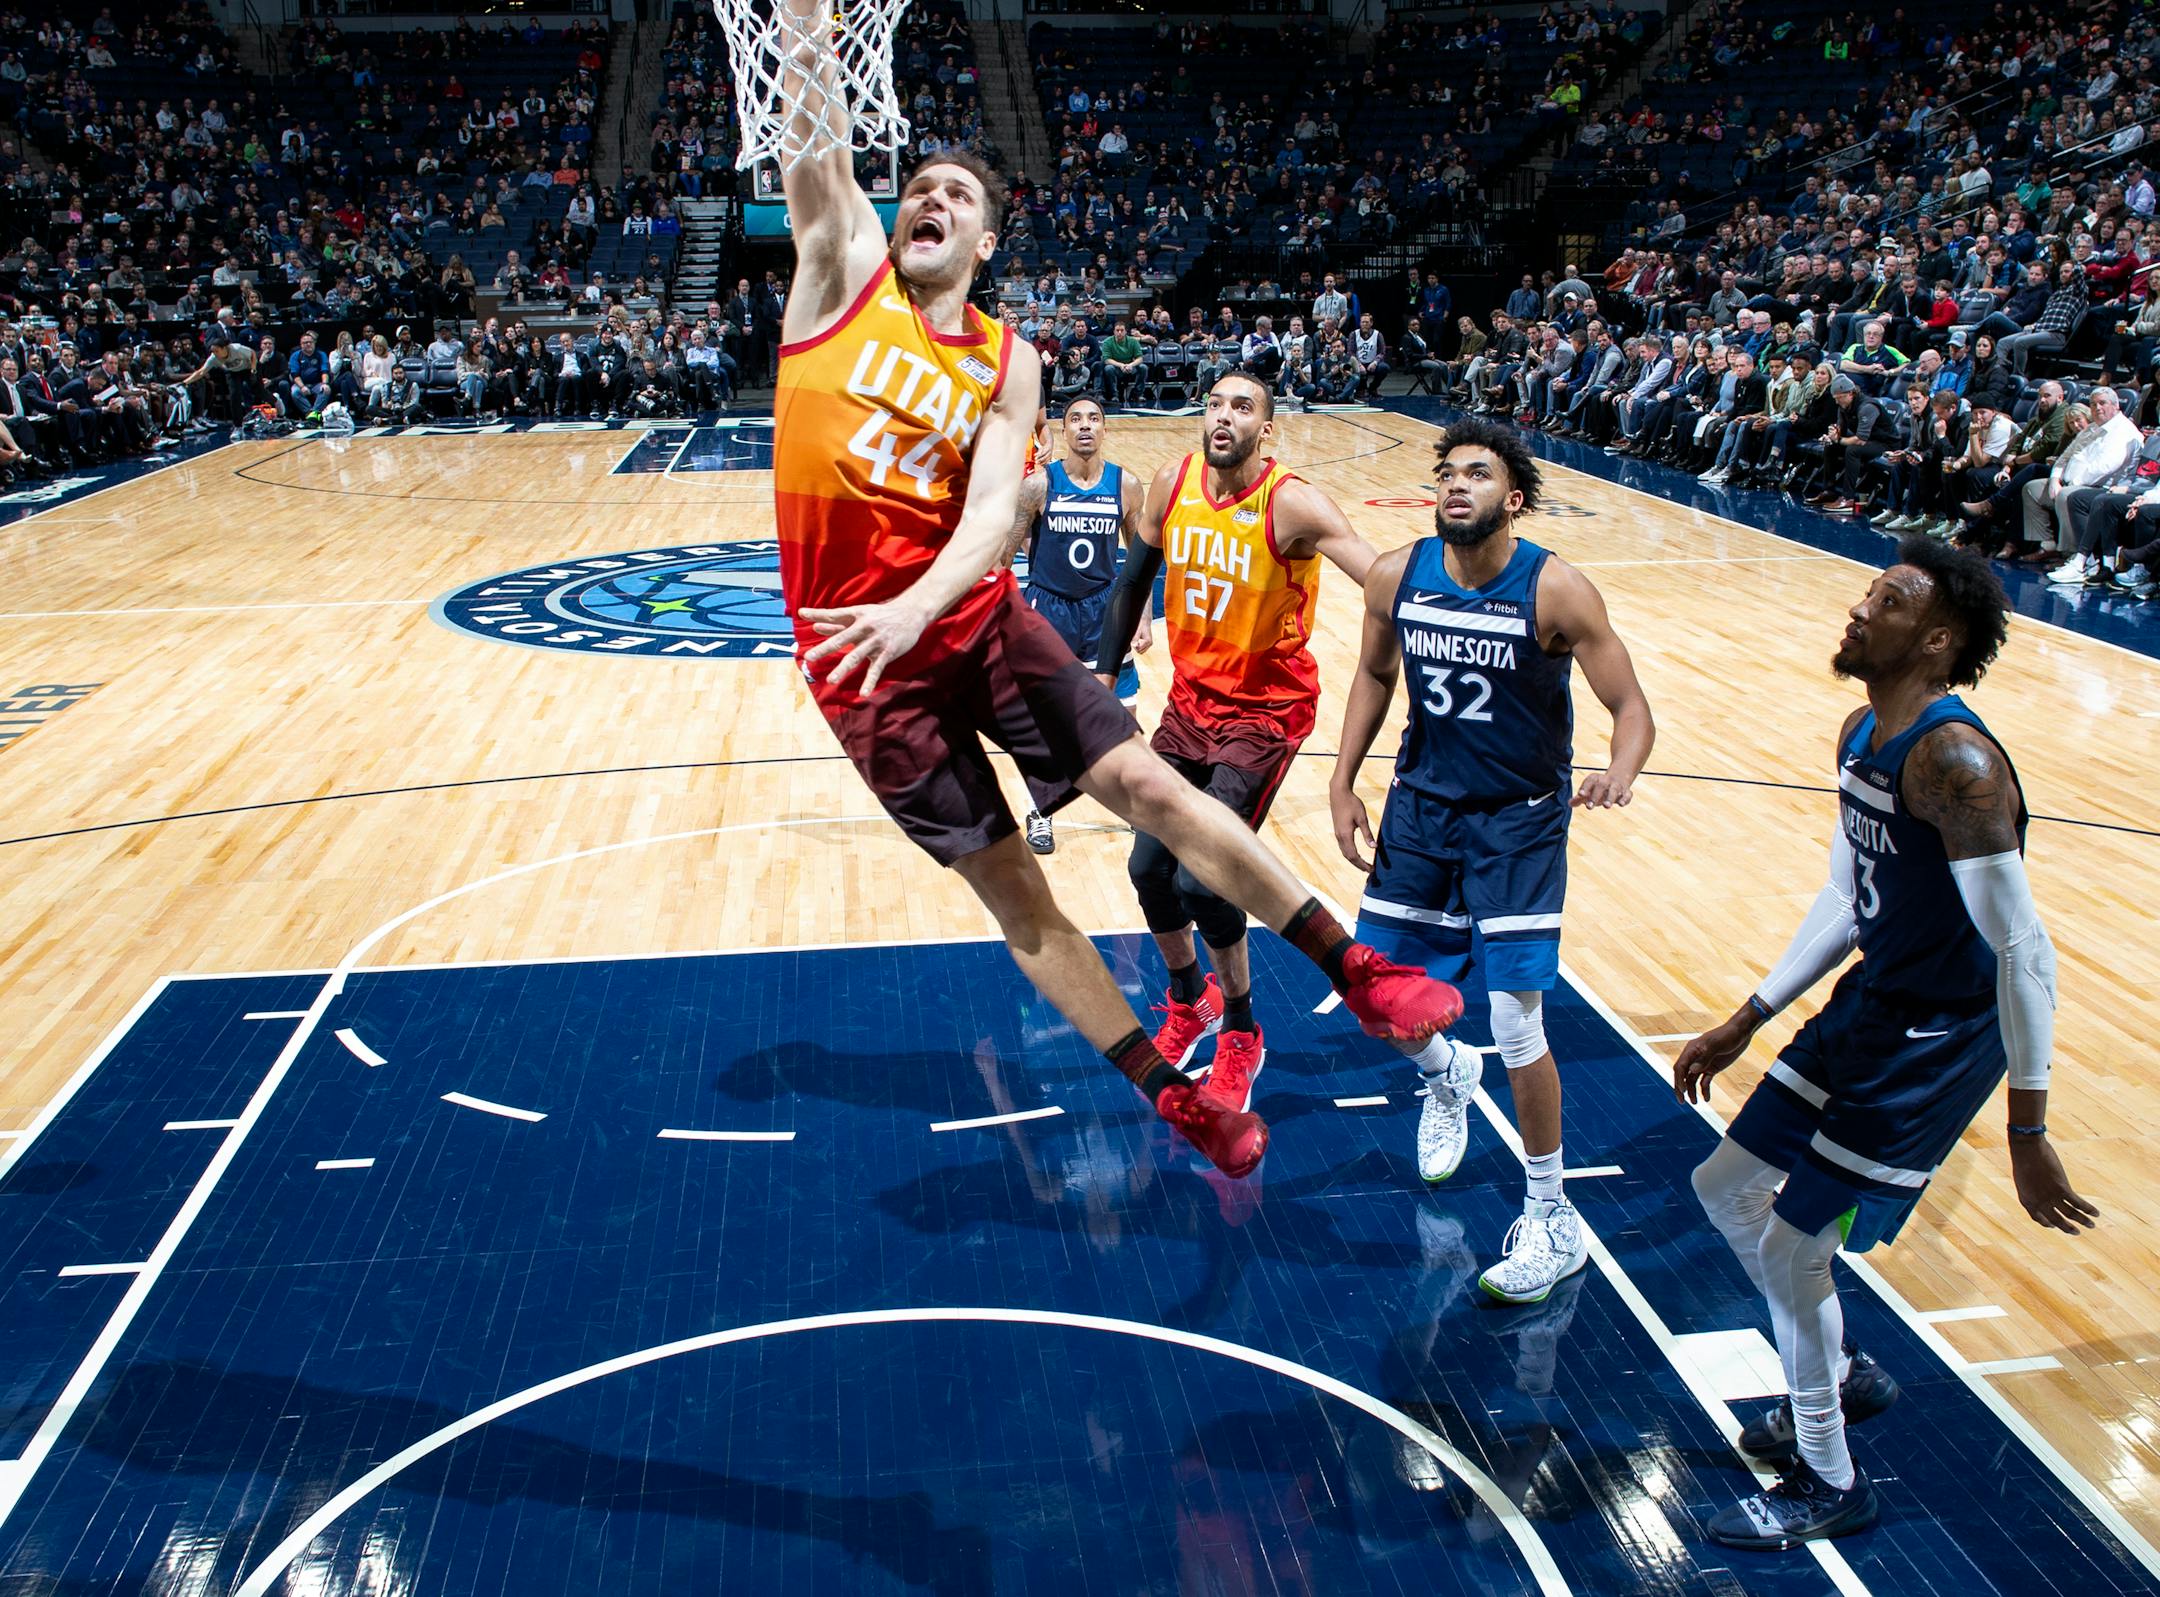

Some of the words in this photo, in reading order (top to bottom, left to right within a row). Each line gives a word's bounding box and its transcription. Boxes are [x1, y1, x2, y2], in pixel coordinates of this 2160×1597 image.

[847, 340, 981, 450] UTAH
[847, 408, 942, 498] 44
[1047, 515, 1117, 535] MINNESOTA
[1068, 538, 1095, 569] 0
[1171, 526, 1252, 583] UTAH
[1184, 570, 1234, 622] 27
[1493, 602, 1518, 615] fitbit
[469, 602, 799, 655] NNESOTA
[1403, 626, 1516, 671] MINNESOTA
[1421, 665, 1493, 722] 32
[1841, 801, 1899, 854] NESOTA
[1850, 848, 1881, 919] 3
